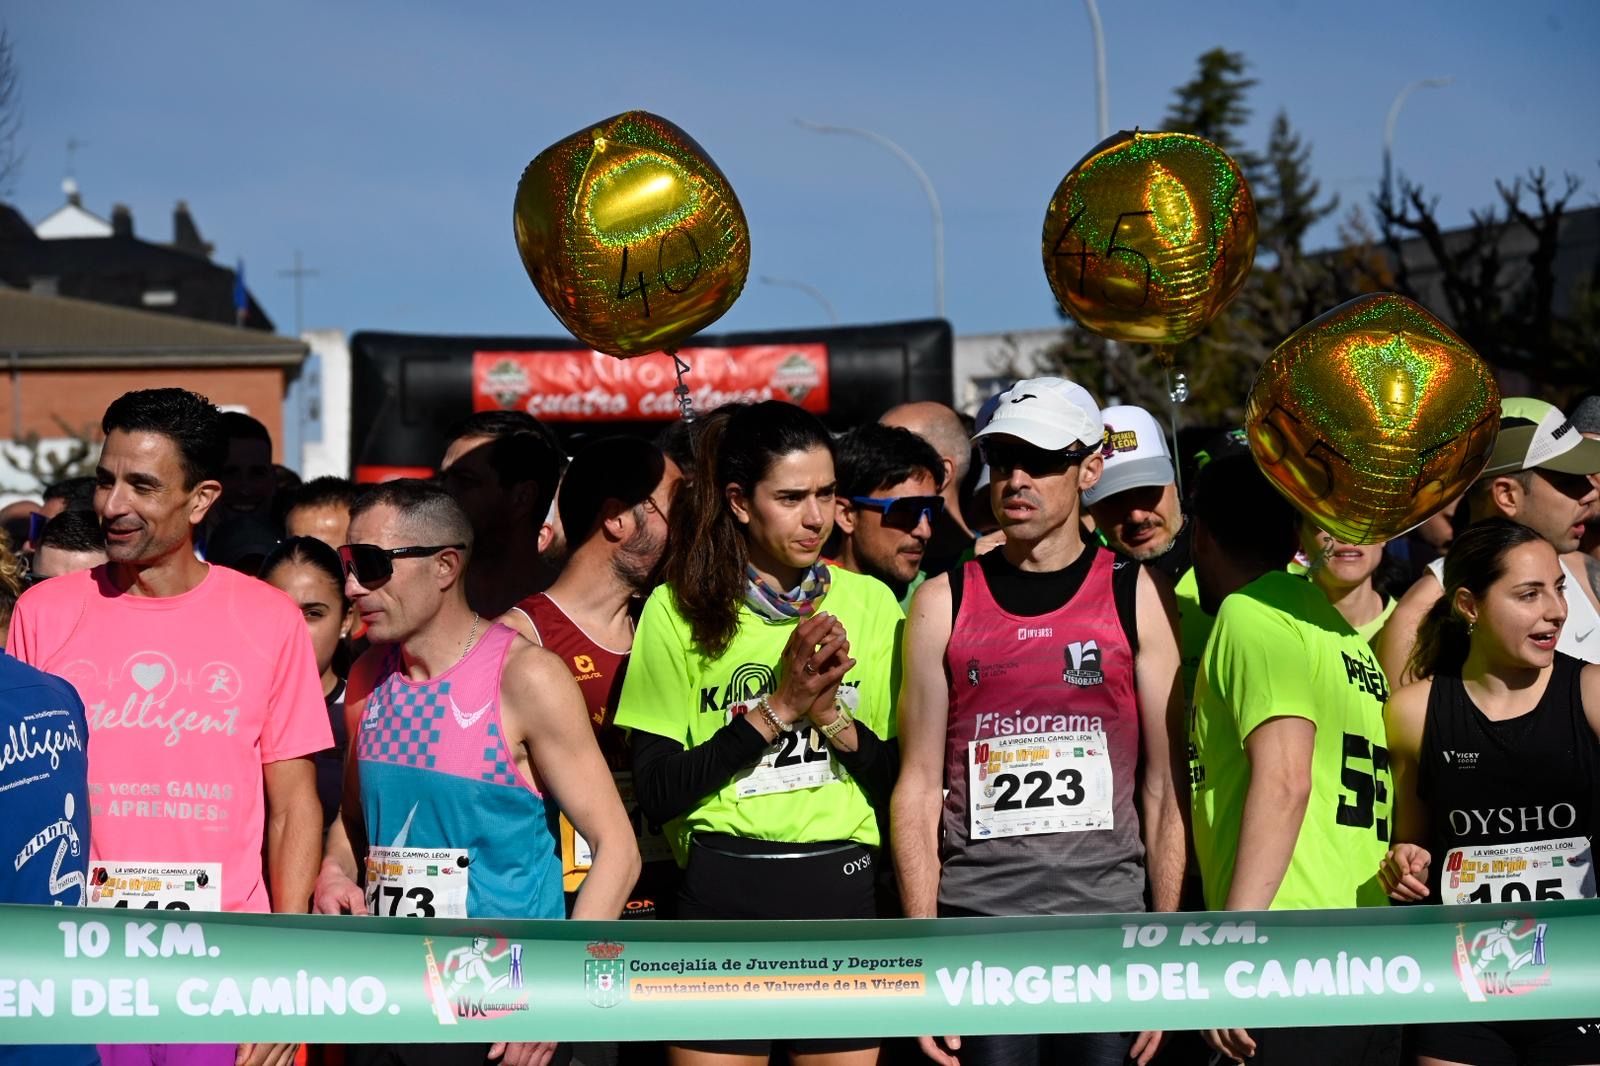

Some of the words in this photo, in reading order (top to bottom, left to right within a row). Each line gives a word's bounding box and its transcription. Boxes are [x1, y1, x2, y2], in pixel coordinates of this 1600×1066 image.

[1052, 205, 1153, 308] 45
[617, 227, 701, 318] 40
[974, 710, 1102, 738] Fisiorama
[975, 743, 989, 764] 10
[108, 782, 161, 796] veces
[167, 781, 233, 800] GANAS
[993, 769, 1085, 812] 223
[1449, 802, 1577, 837] OYSHO
[1446, 851, 1463, 872] 10
[1483, 847, 1508, 856] VIRGEN
[371, 884, 436, 918] 173
[58, 921, 110, 958] 10
[125, 922, 221, 958] KM.
[1122, 923, 1168, 949] 10
[1180, 921, 1269, 946] KM.
[630, 957, 717, 974] Concejalía
[721, 958, 742, 971] de
[746, 957, 828, 970] Juventud
[832, 959, 844, 972] y
[848, 956, 923, 971] Deportes
[634, 981, 739, 996] Ayuntamiento
[743, 981, 760, 992] de
[764, 979, 829, 992] Valverde
[833, 979, 850, 991] de
[854, 979, 867, 990] la
[871, 978, 920, 991] Virgen
[1126, 961, 1209, 1001] DEL
[71, 977, 160, 1017] DEL
